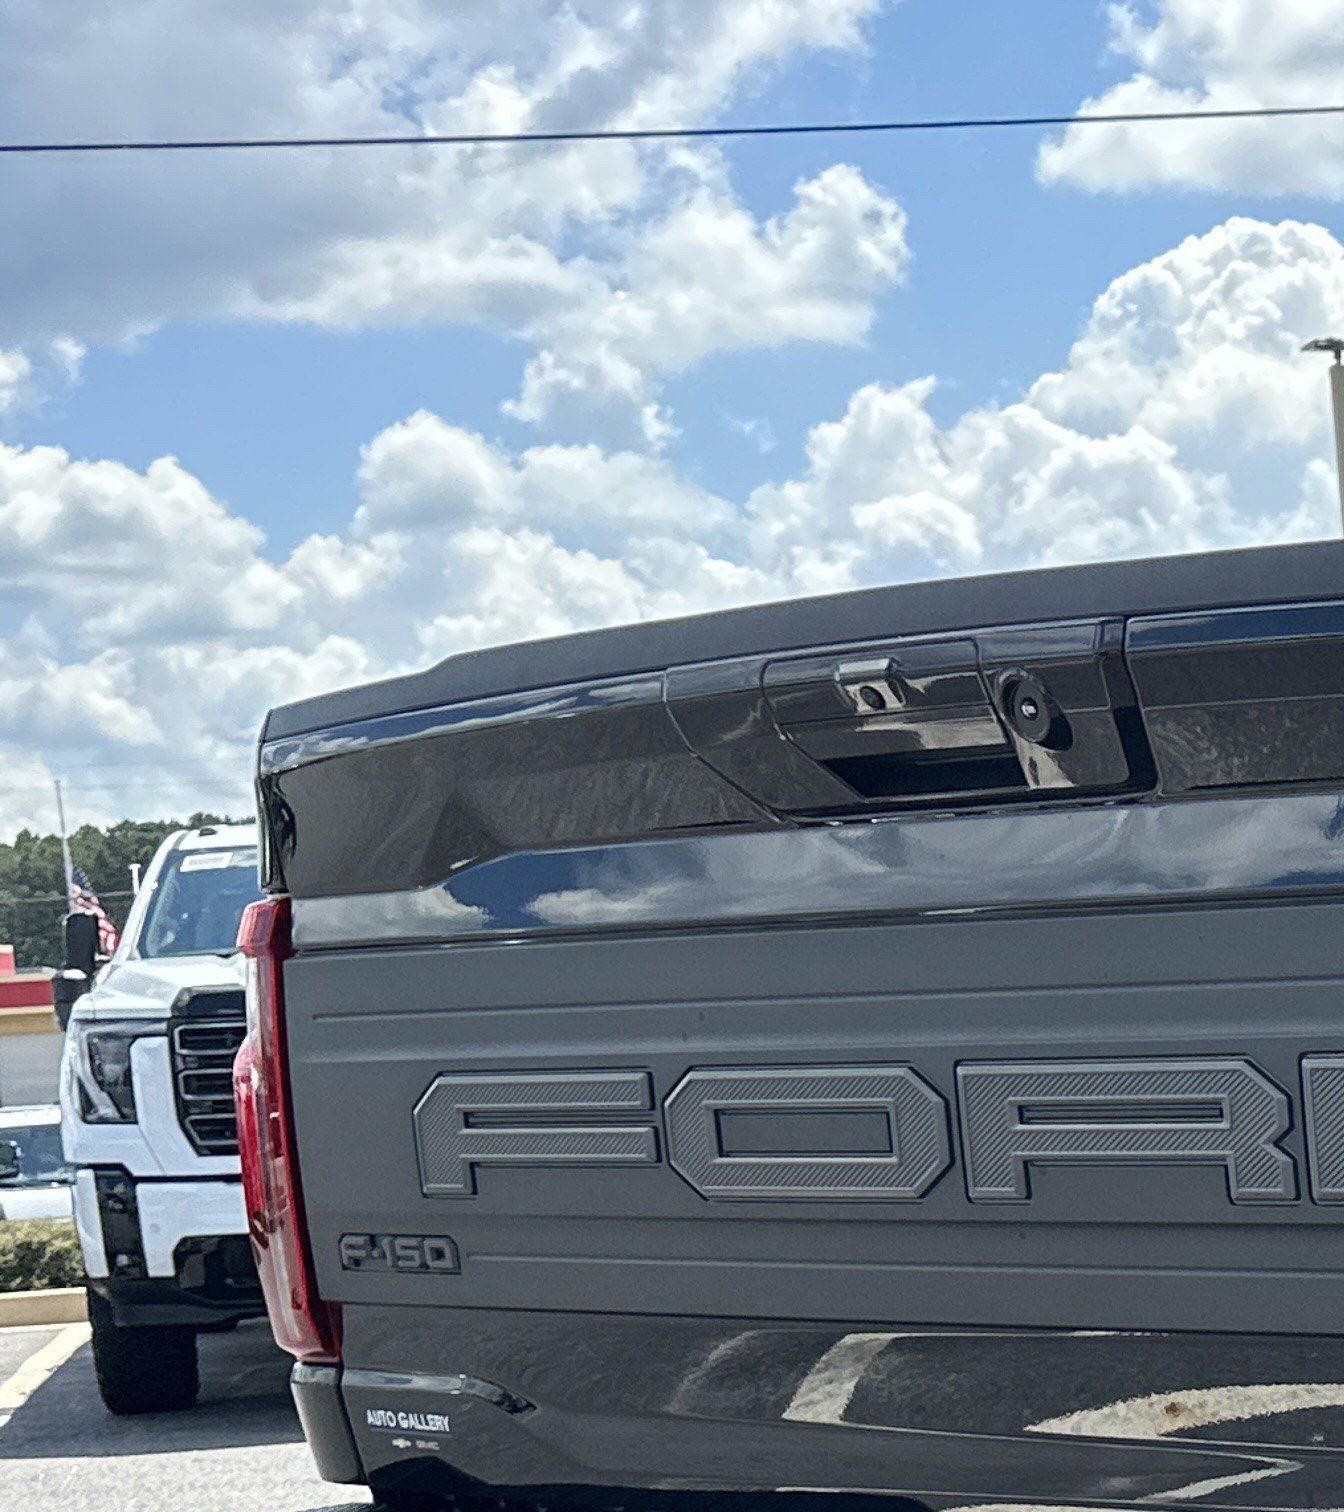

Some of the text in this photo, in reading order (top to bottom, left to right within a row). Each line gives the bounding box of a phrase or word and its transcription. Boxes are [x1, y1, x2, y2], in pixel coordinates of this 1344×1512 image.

[339, 1233, 461, 1274] F-150
[366, 1409, 450, 1432] AUTO GALLERY
